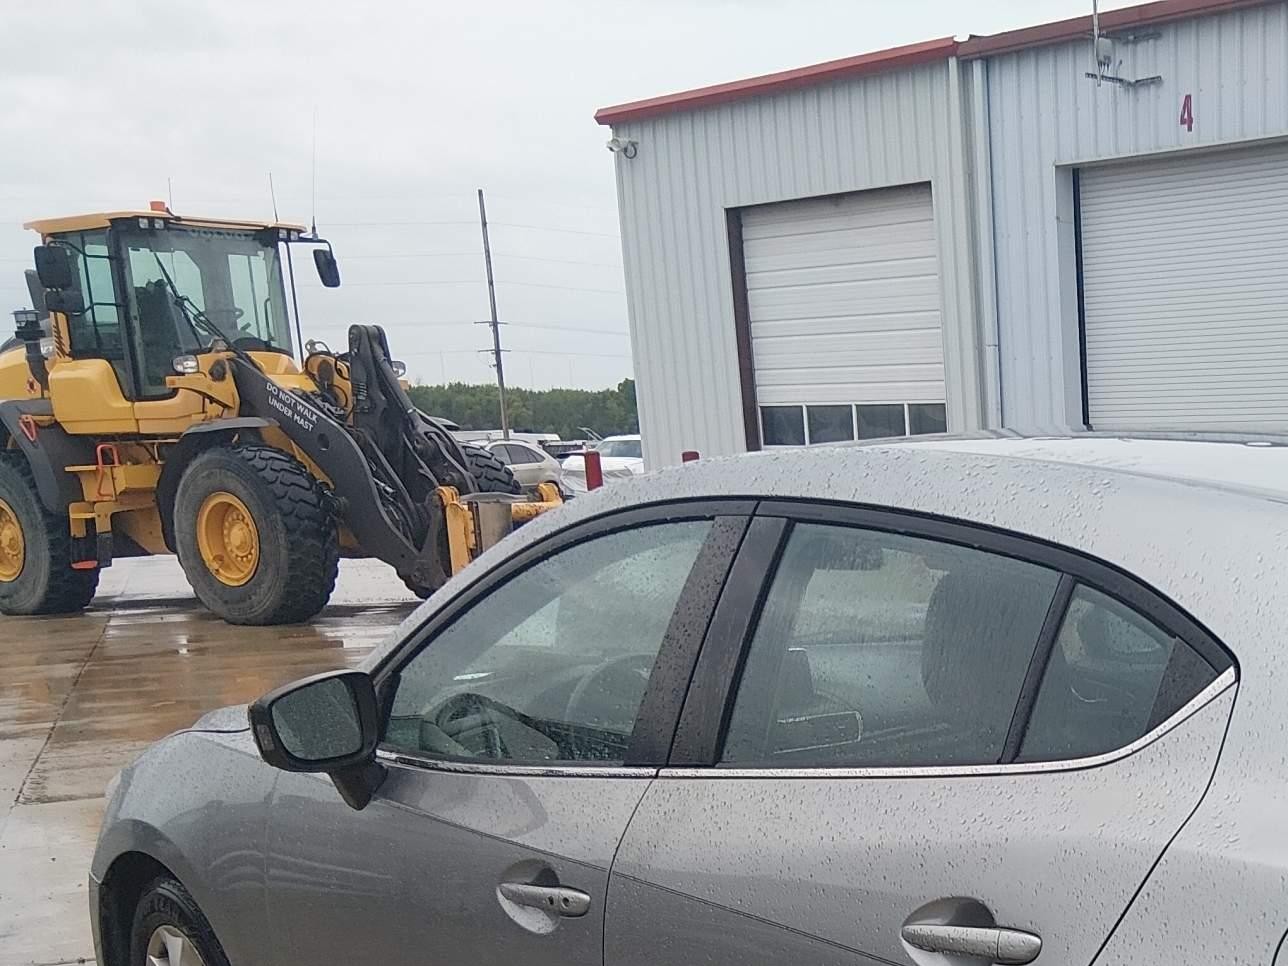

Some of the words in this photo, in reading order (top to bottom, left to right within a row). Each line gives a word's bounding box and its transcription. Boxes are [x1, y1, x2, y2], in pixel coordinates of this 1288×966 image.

[1180, 94, 1193, 132] 4
[266, 382, 278, 395] DO
[278, 390, 296, 407] NOT
[296, 402, 318, 424] WALK
[268, 395, 293, 418] UNDER
[293, 412, 314, 431] MAST
